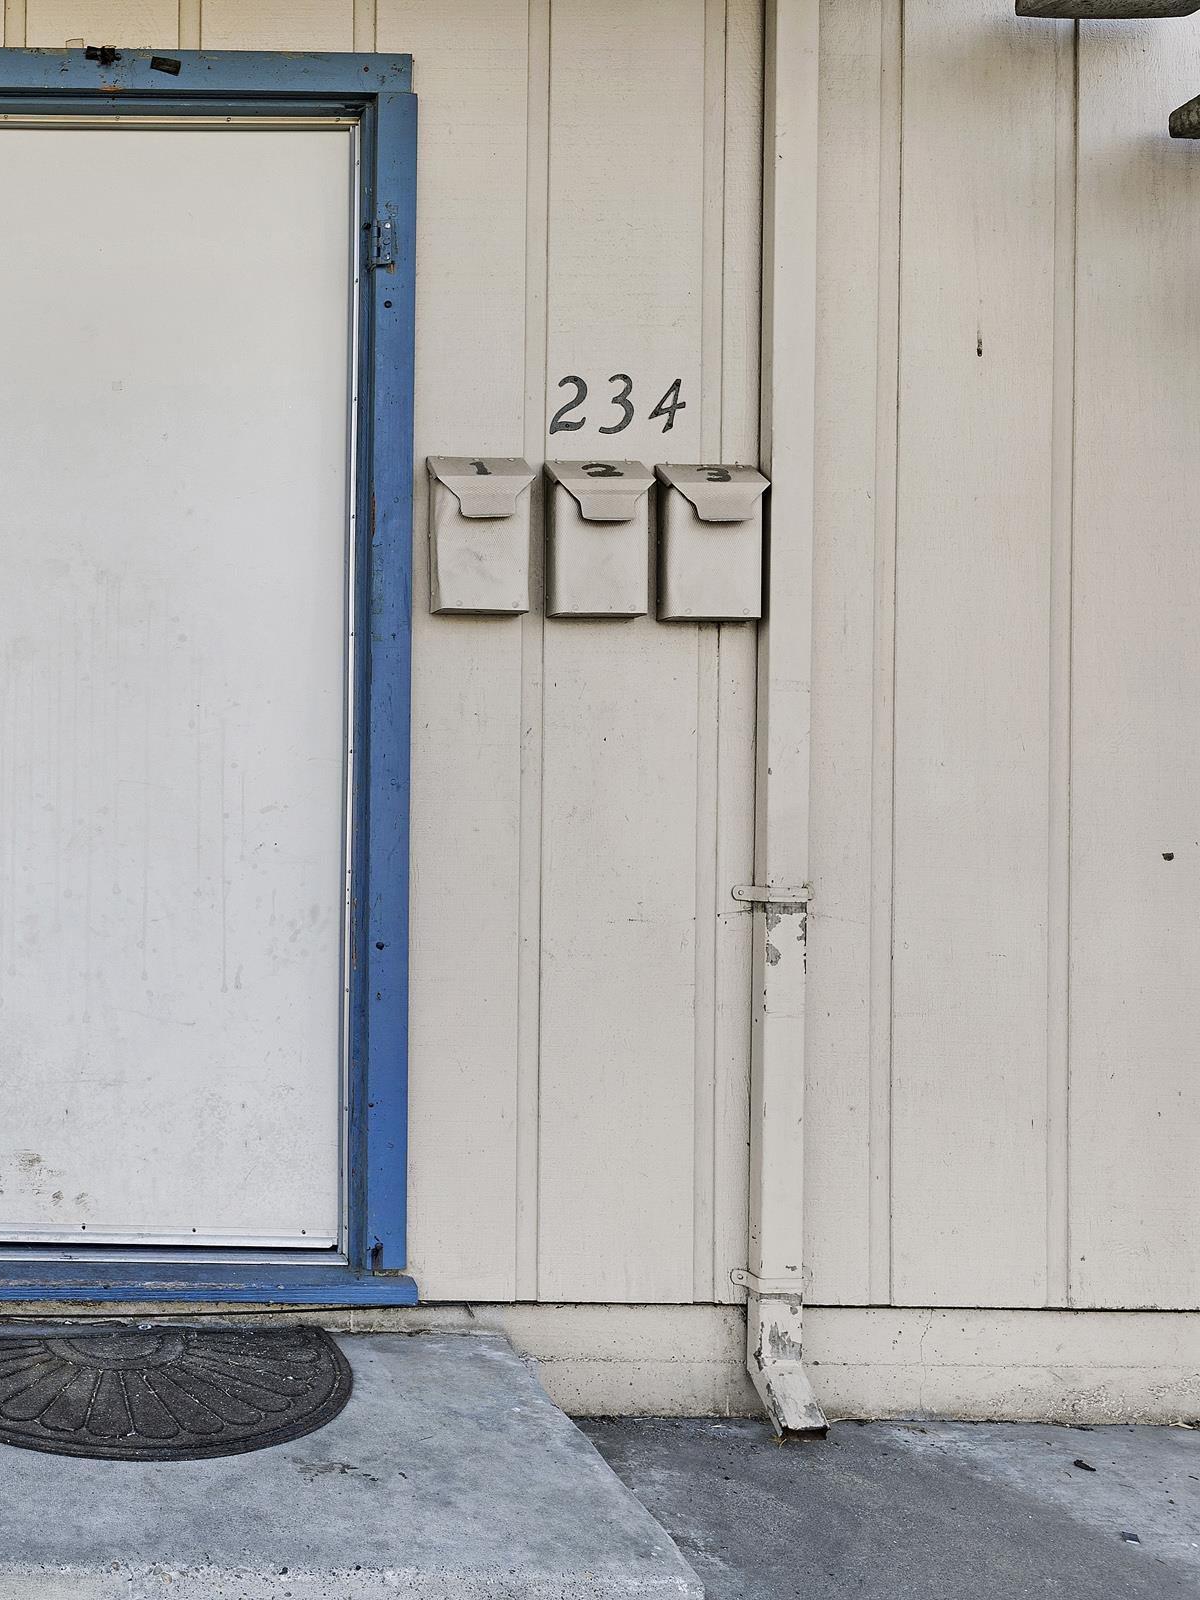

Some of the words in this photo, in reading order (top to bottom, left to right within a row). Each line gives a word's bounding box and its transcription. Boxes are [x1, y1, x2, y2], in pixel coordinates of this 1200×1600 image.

[549, 374, 686, 434] 234
[469, 461, 493, 475] 1
[581, 463, 624, 477] 2
[697, 467, 731, 482] 3
